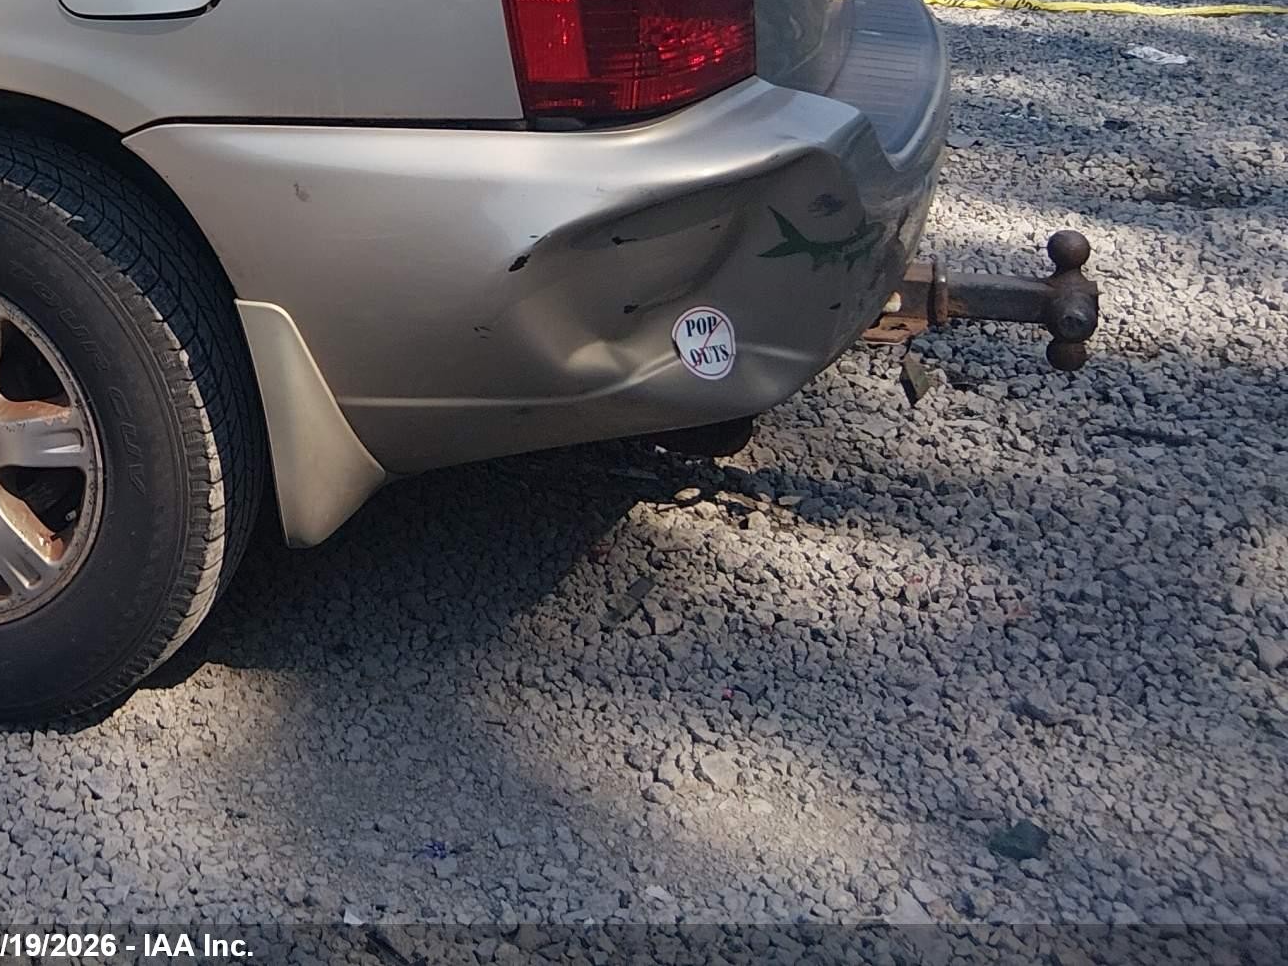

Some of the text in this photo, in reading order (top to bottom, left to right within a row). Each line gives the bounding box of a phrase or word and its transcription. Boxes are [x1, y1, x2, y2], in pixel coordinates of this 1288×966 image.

[685, 316, 717, 337] POP
[690, 344, 729, 365] OUTS
[109, 386, 146, 496] CUV
